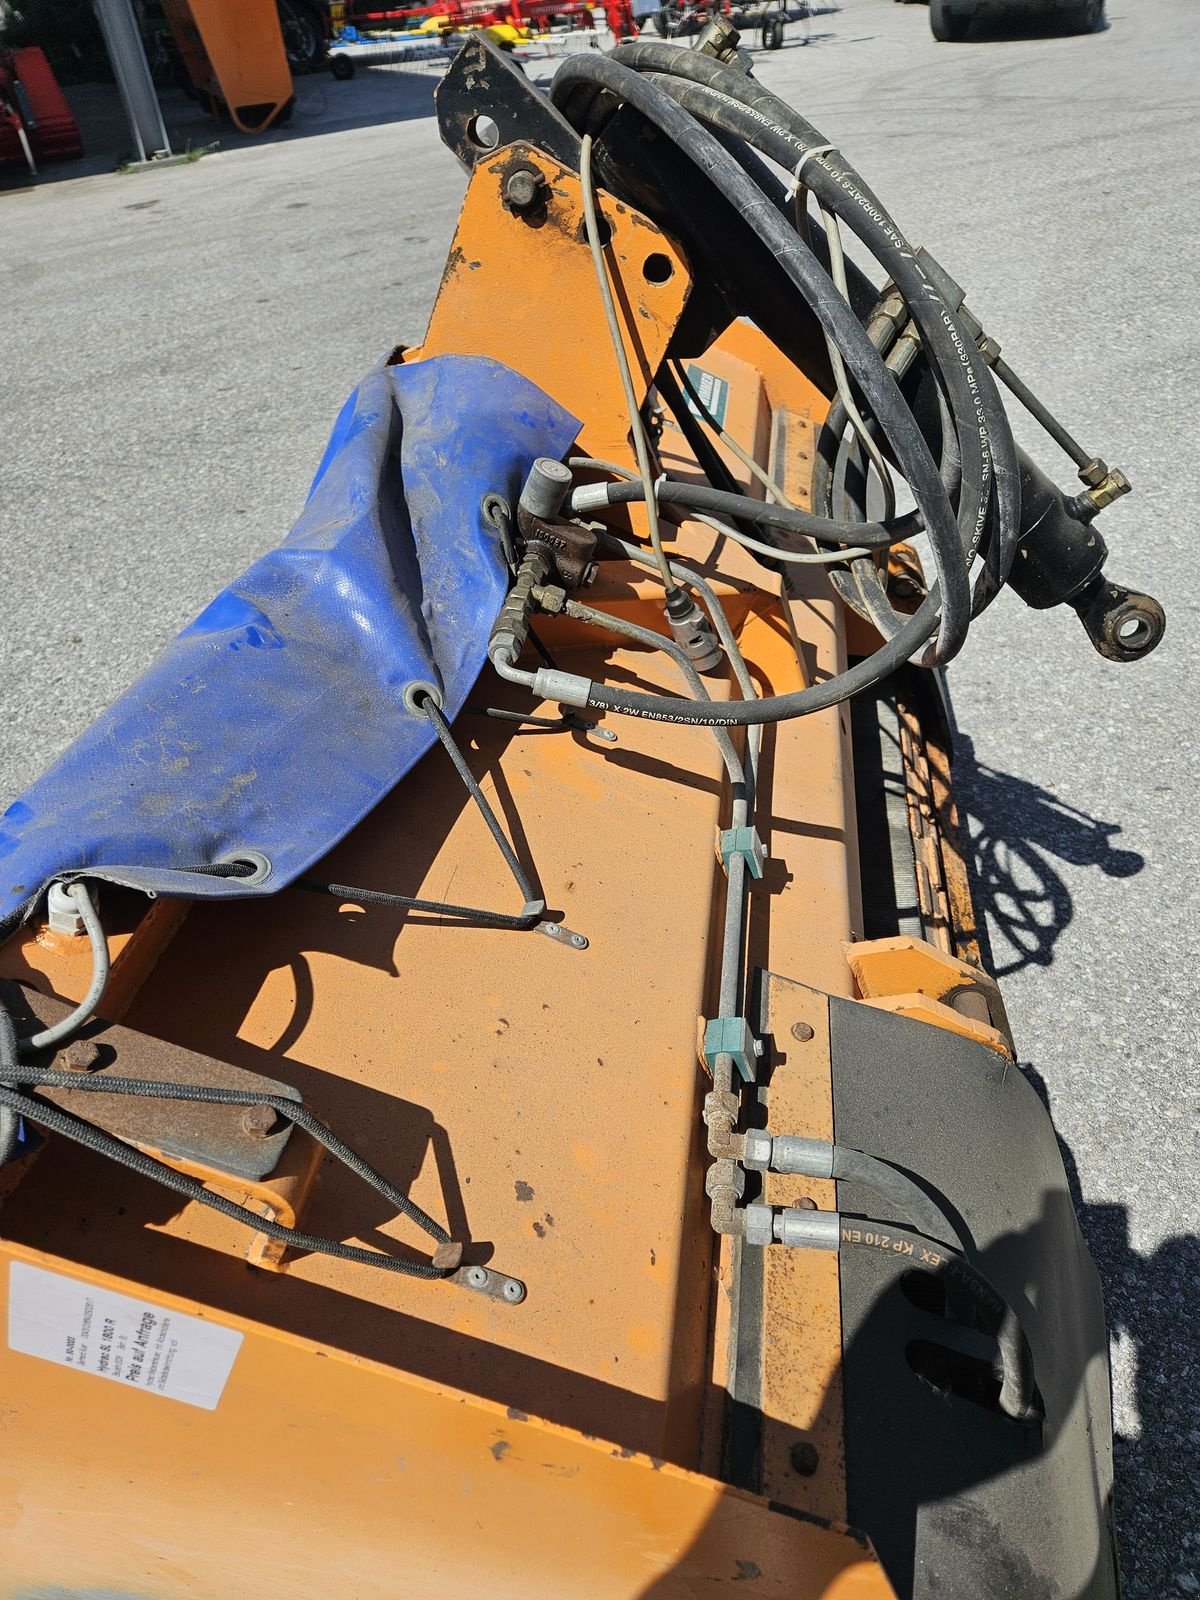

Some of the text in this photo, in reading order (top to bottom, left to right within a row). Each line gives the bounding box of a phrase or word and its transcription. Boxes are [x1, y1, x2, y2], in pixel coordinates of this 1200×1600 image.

[769, 123, 785, 137] 2W
[815, 155, 832, 171] mm
[830, 170, 846, 185] 10
[841, 180, 884, 226] 100R2AT-6
[884, 227, 904, 248] SAE
[941, 310, 970, 366] (330BAR)
[967, 367, 980, 395] MPa
[973, 396, 986, 423] 33.0
[979, 426, 990, 448] WP
[588, 698, 738, 726] 3/8) X 2W EN853/2SN/10/DIN
[841, 1228, 861, 1243] EN
[865, 1231, 891, 1248] 210
[892, 1240, 914, 1256] KP
[102, 1325, 115, 1343] 1800
[125, 1310, 158, 1383] Preis auf Anfrage
